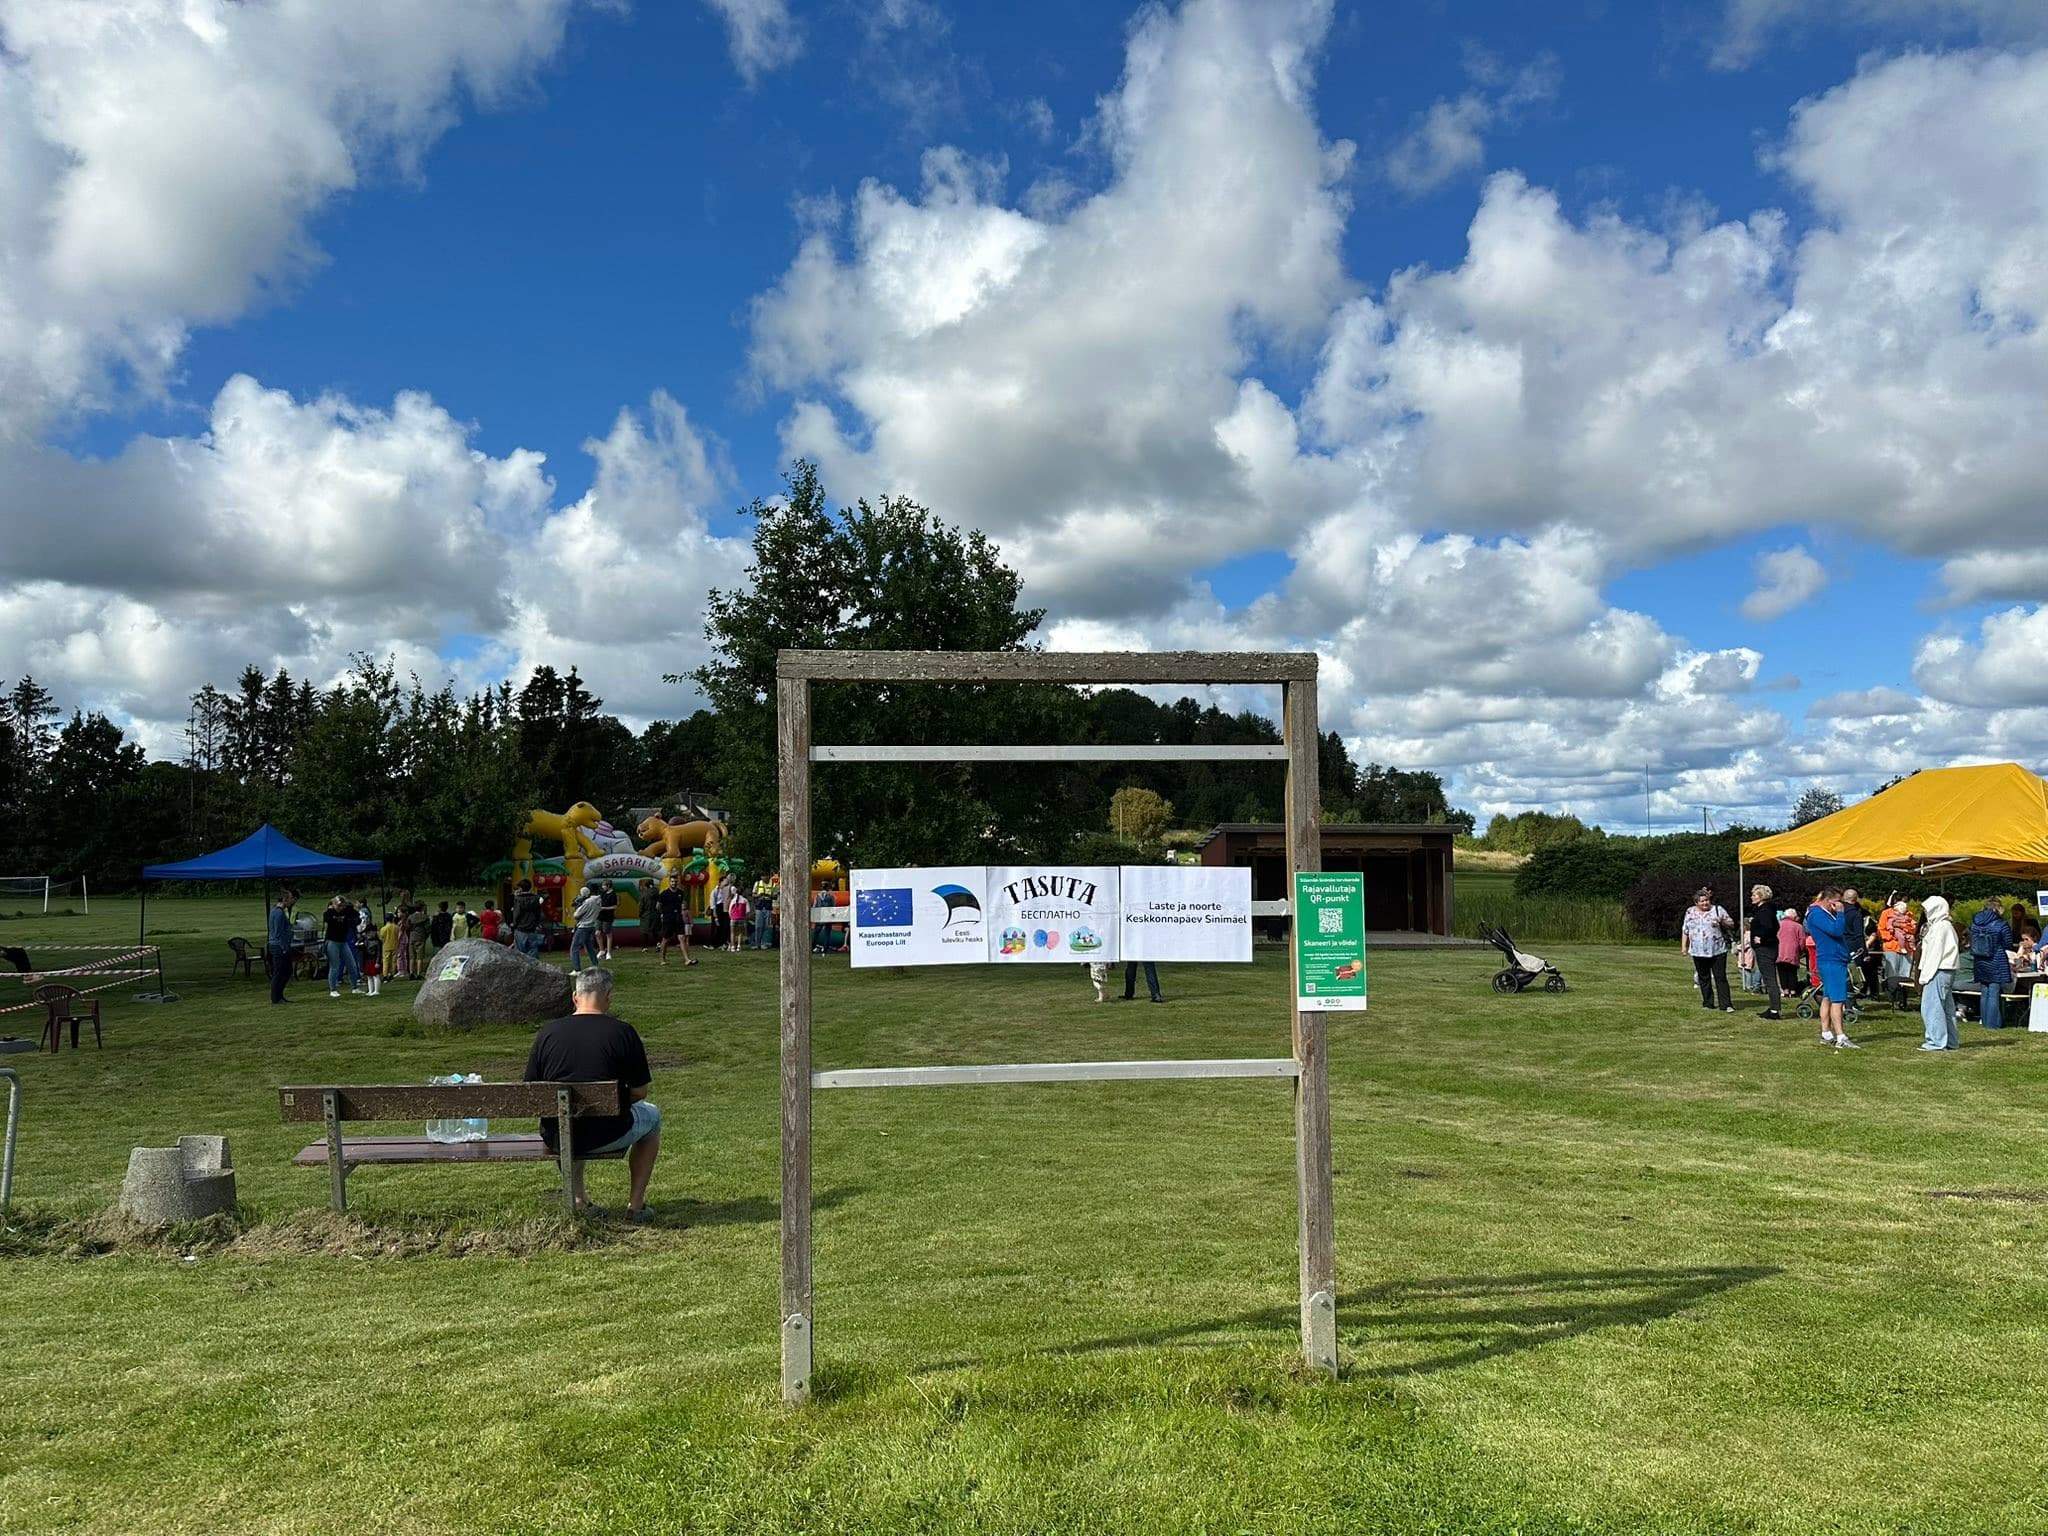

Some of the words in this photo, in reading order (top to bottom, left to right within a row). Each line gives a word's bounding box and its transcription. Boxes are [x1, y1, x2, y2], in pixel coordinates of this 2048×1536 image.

[604, 857, 646, 869] SAFARI
[1003, 875, 1098, 906] TASUTA
[1302, 885, 1357, 894] Rajavallutaja
[1310, 894, 1350, 904] QR-punkt
[1149, 901, 1176, 911] Laste
[1177, 901, 1187, 912] ja
[1189, 902, 1222, 911] noorte
[1021, 910, 1081, 919] БЕСПЛАТНО
[1126, 914, 1202, 924] Keskkonnapäev
[1205, 914, 1247, 924] Sinimäel
[858, 931, 911, 939] Kaasrahastanud
[866, 939, 894, 947] Euroopa
[895, 938, 906, 946] Liit
[1304, 939, 1330, 947] Skaneeri
